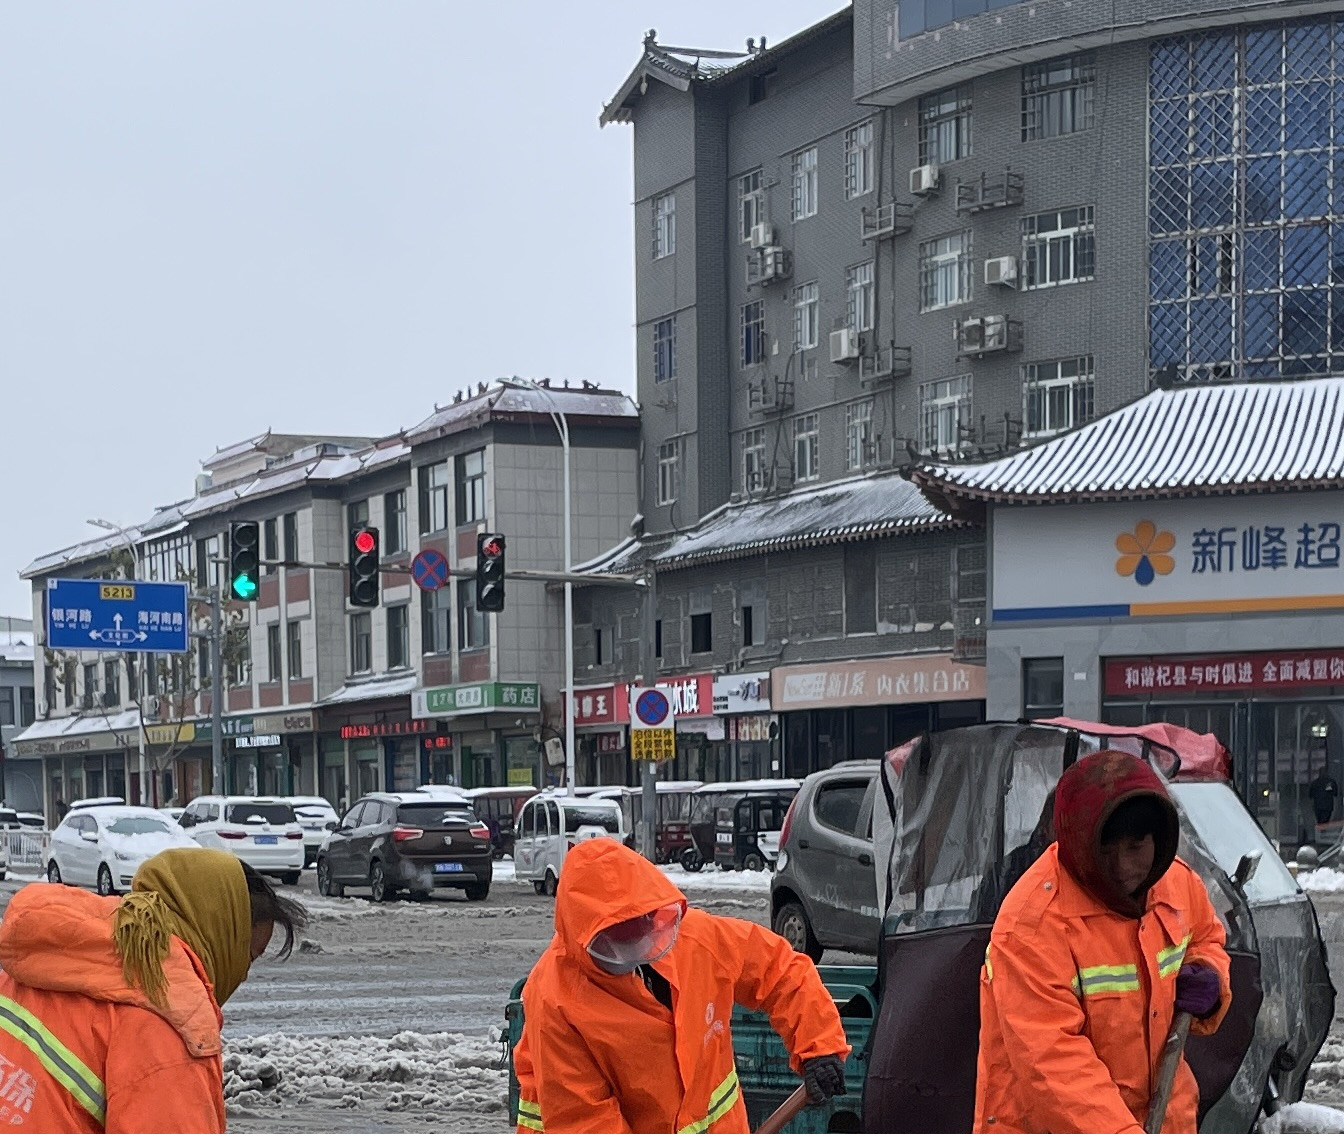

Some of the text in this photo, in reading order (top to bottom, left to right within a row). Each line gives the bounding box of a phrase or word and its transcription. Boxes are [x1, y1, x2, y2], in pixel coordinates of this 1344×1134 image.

[877, 669, 971, 696] 内衣集合店
[1124, 661, 1254, 688] 和谐杞县与时俱进
[502, 687, 535, 704] 药店
